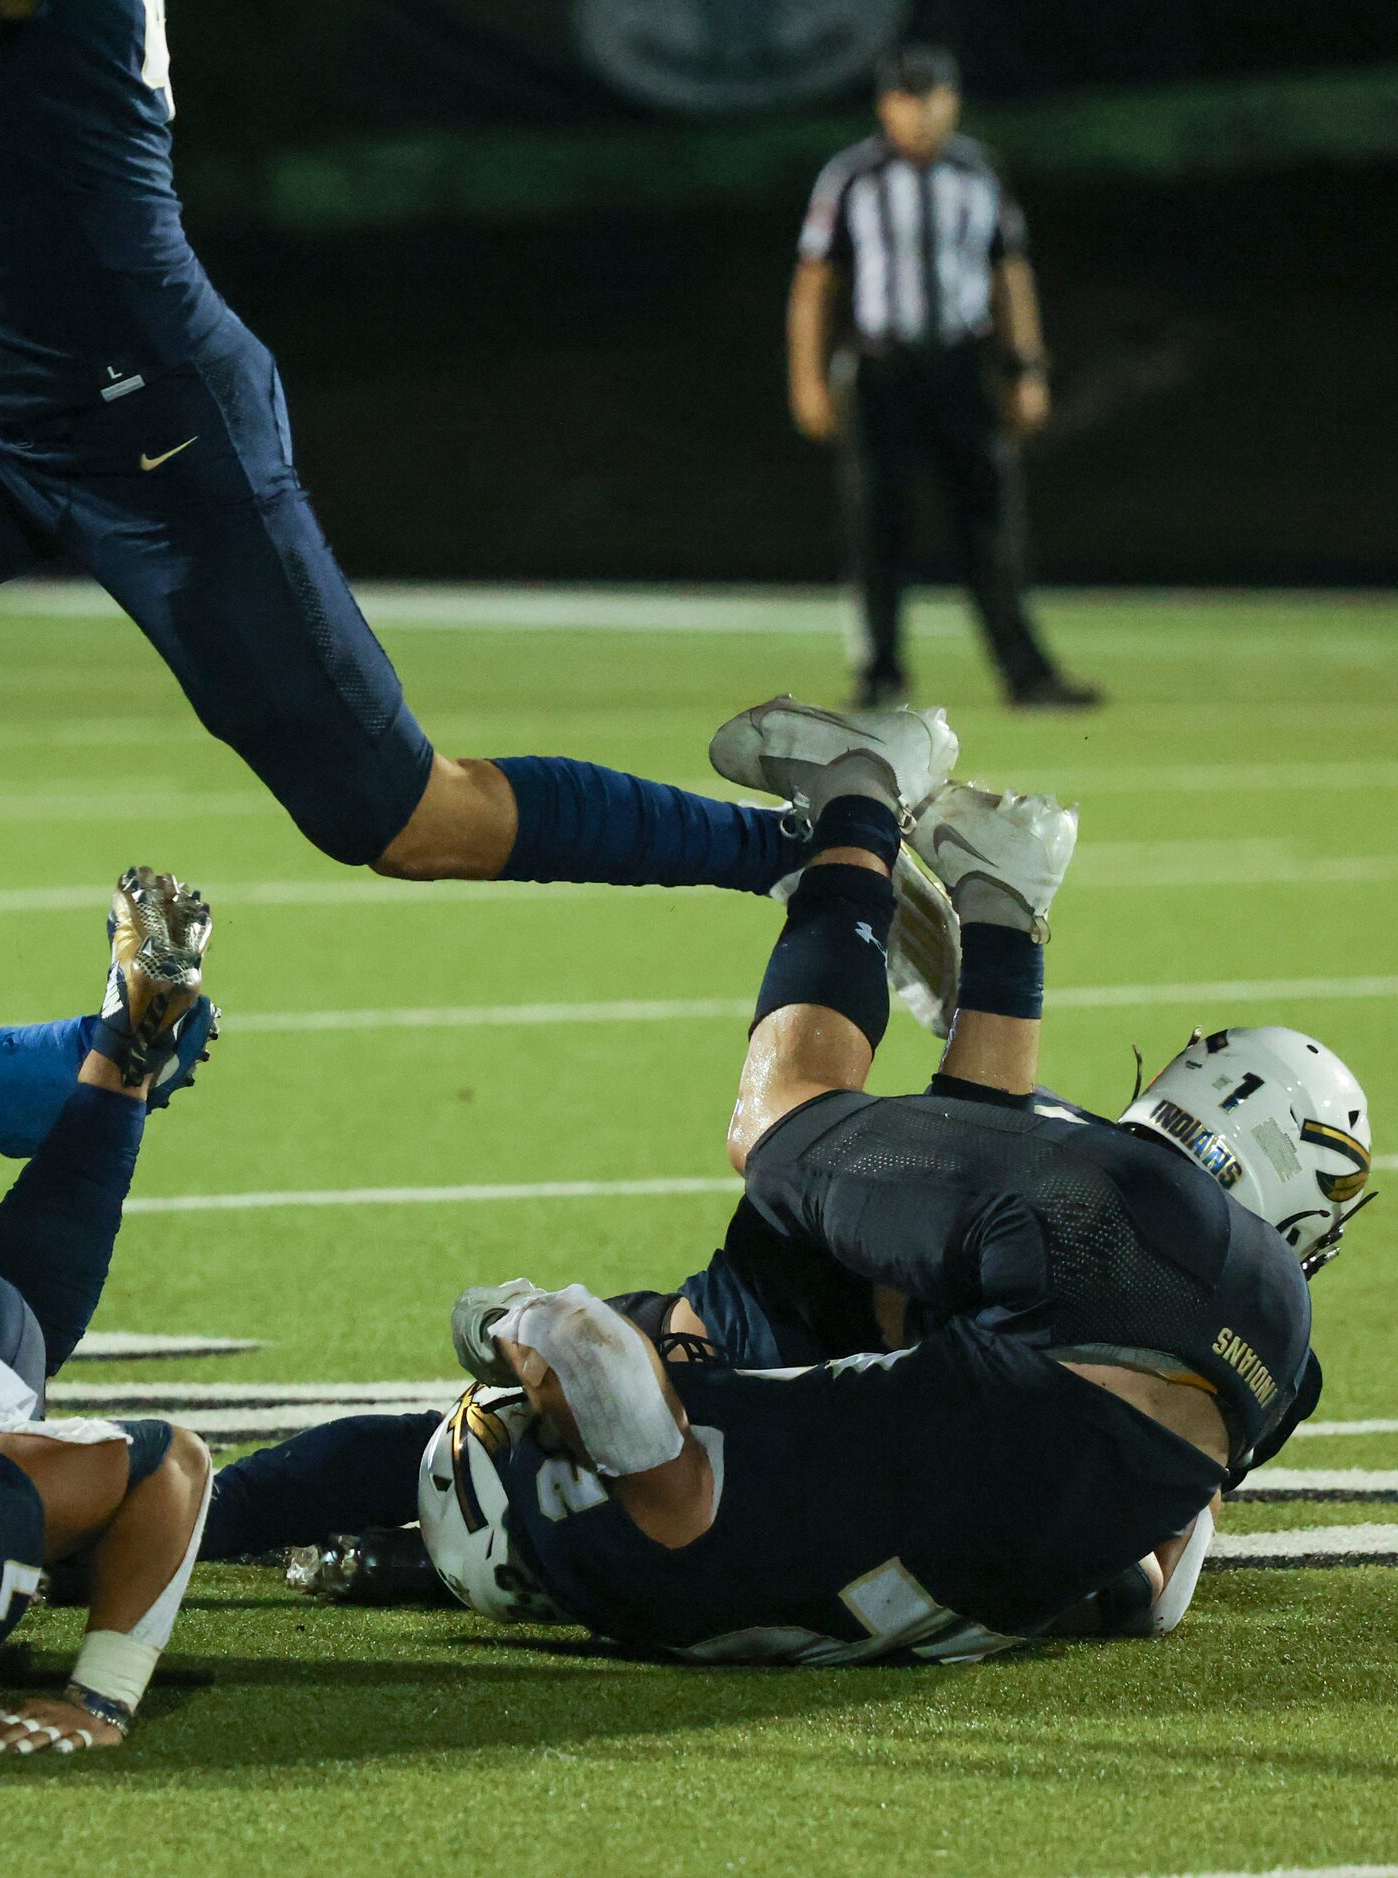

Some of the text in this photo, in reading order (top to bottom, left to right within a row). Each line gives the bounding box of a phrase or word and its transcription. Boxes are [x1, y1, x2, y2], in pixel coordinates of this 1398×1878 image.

[1217, 1071, 1266, 1115] 1
[1148, 1099, 1243, 1190] INDIANS
[1212, 1327, 1278, 1409] INDIANS
